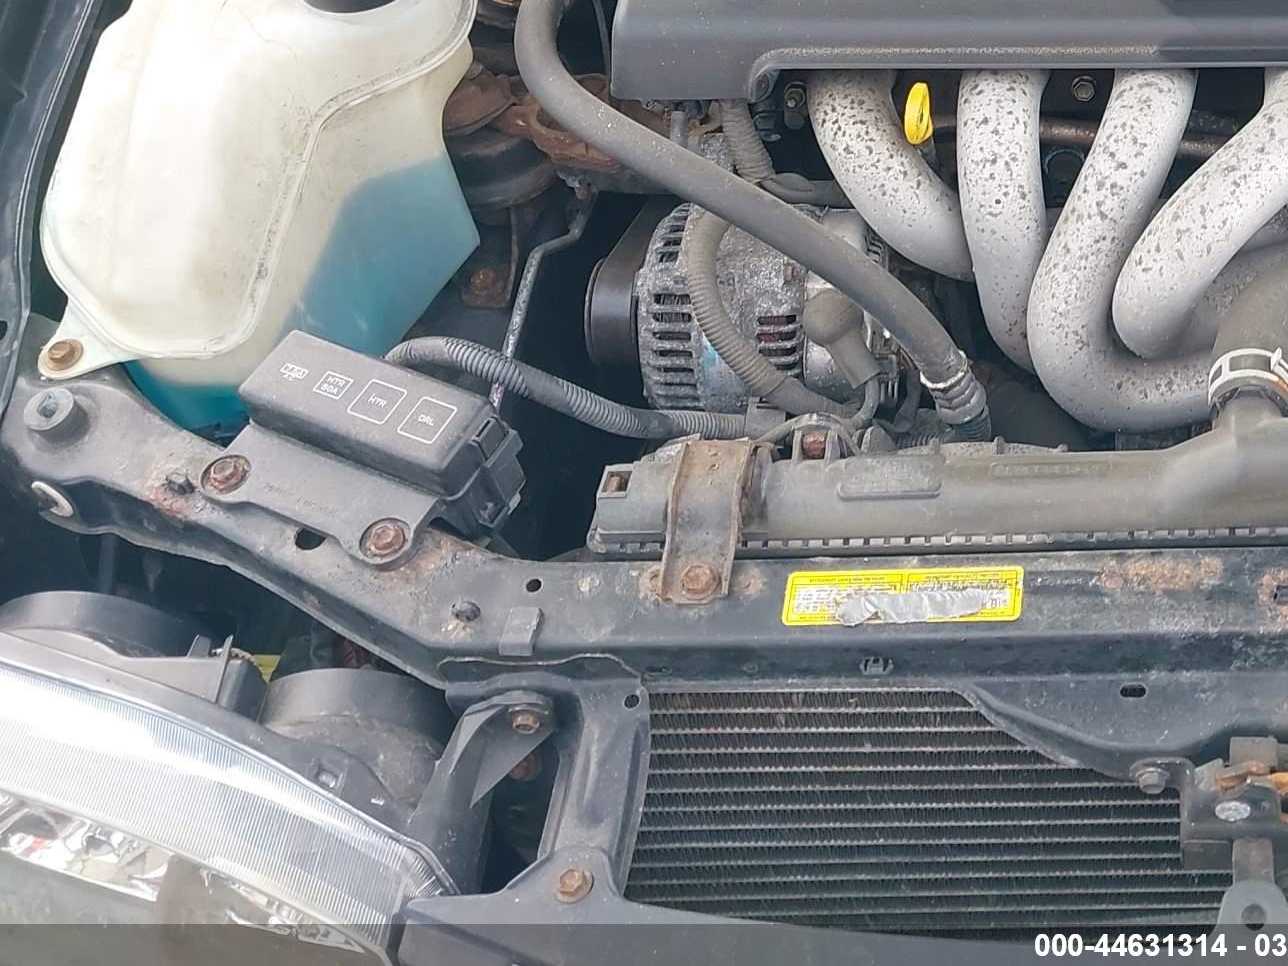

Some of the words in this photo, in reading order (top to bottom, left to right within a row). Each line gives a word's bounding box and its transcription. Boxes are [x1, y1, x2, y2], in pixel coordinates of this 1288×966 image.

[326, 376, 346, 387] HTR
[367, 393, 387, 408] HTR
[417, 413, 435, 427] DRL
